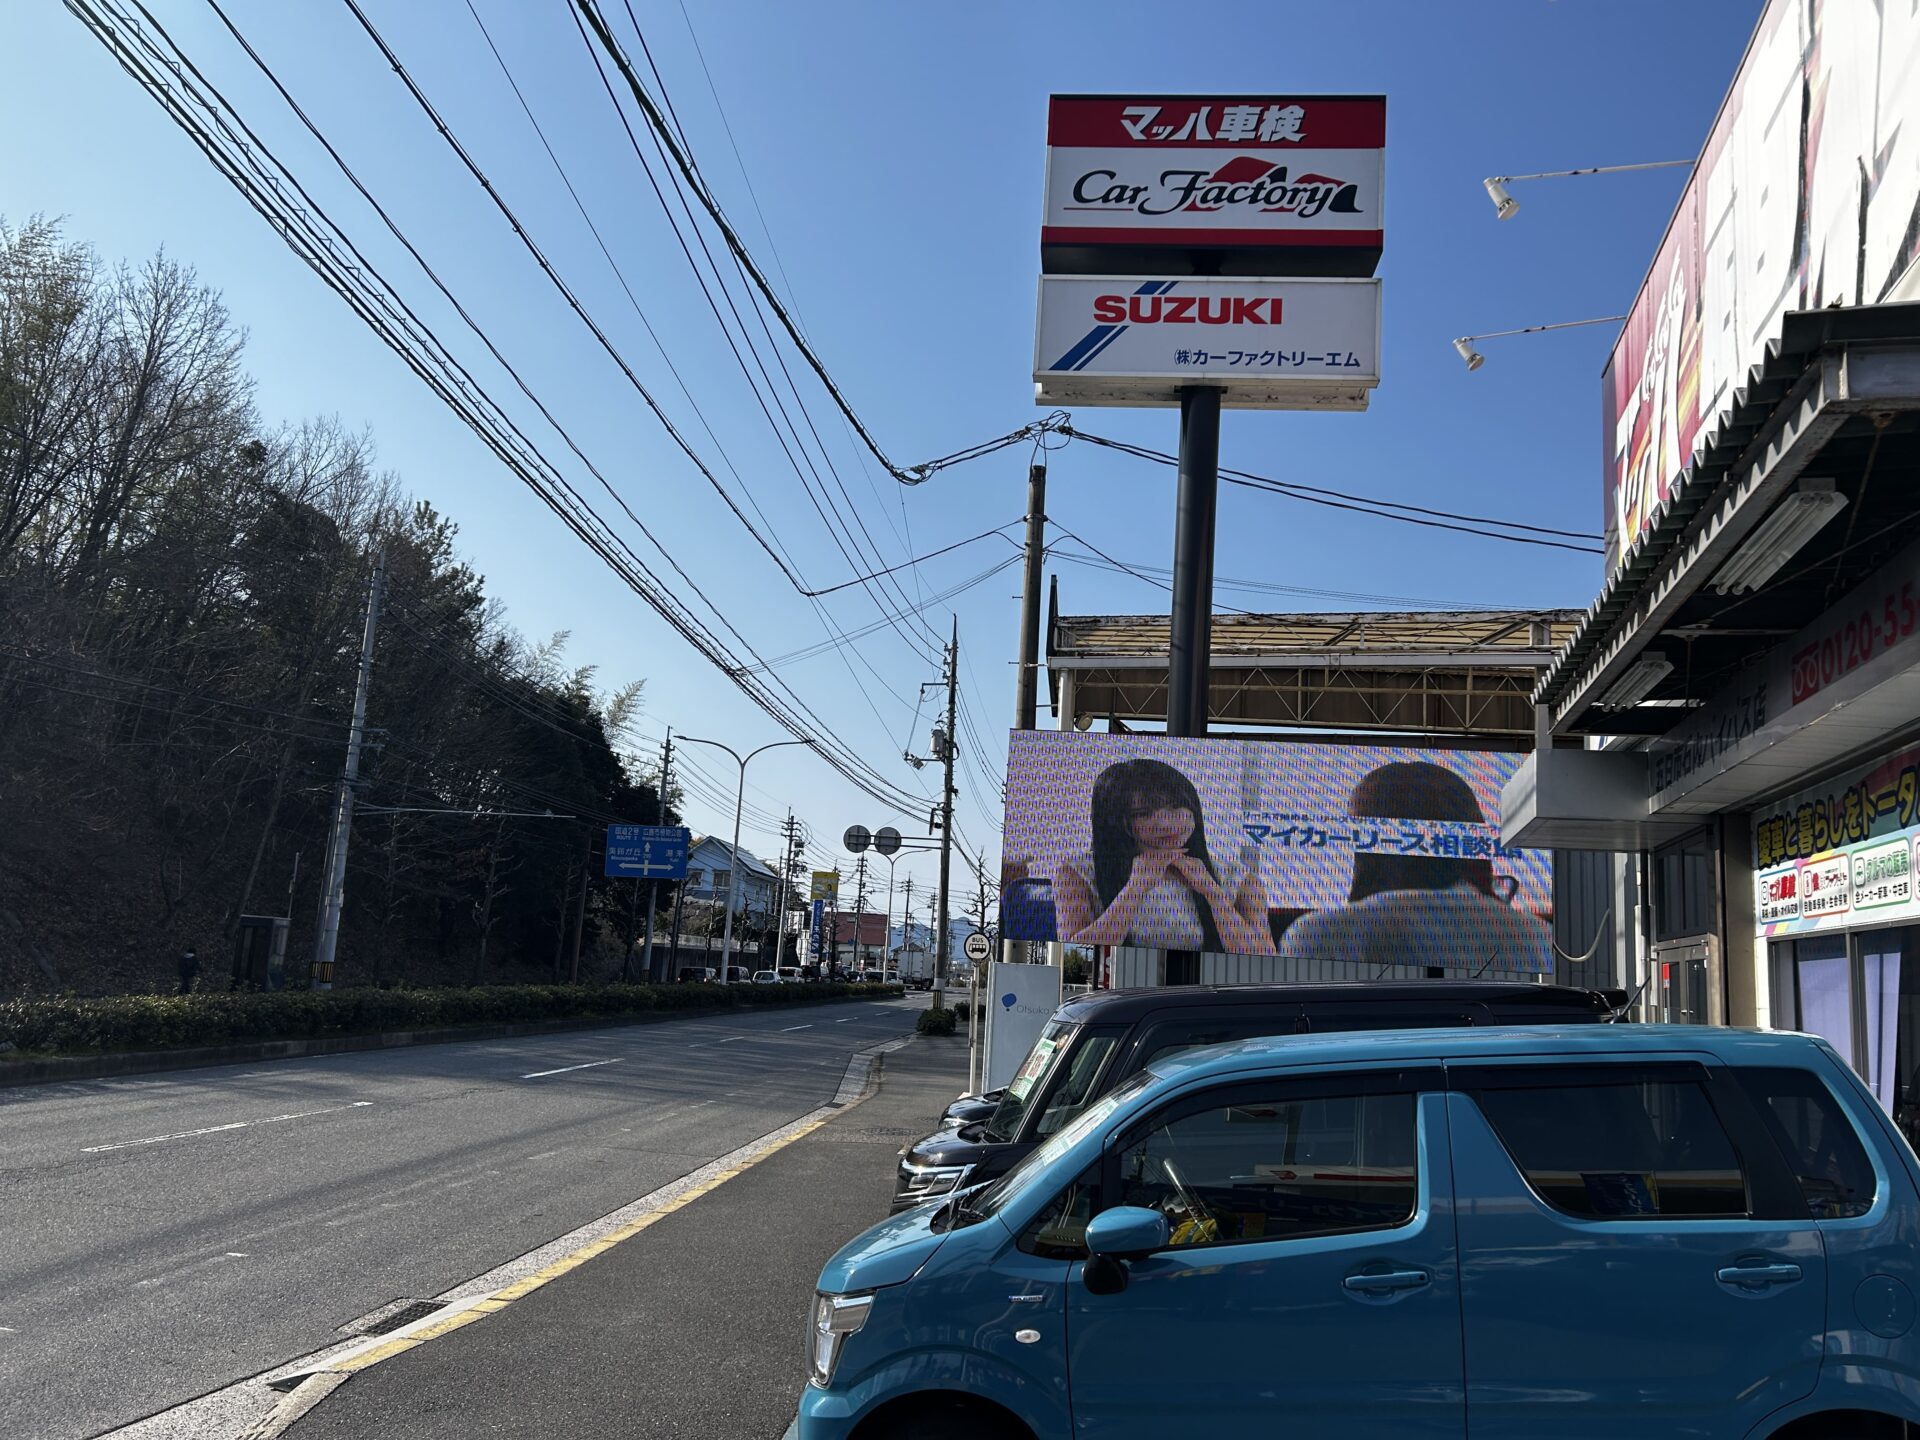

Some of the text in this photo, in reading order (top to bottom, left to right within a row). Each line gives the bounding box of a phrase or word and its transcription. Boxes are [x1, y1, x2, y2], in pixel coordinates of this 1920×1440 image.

[1119, 104, 1308, 143] マッハ車検
[1072, 169, 1337, 218] Car Factory
[1092, 294, 1284, 325] SUZUKI
[1757, 764, 1920, 871] 愛車と暮らしをトータ
[1016, 1004, 1050, 1015] Otsuka
